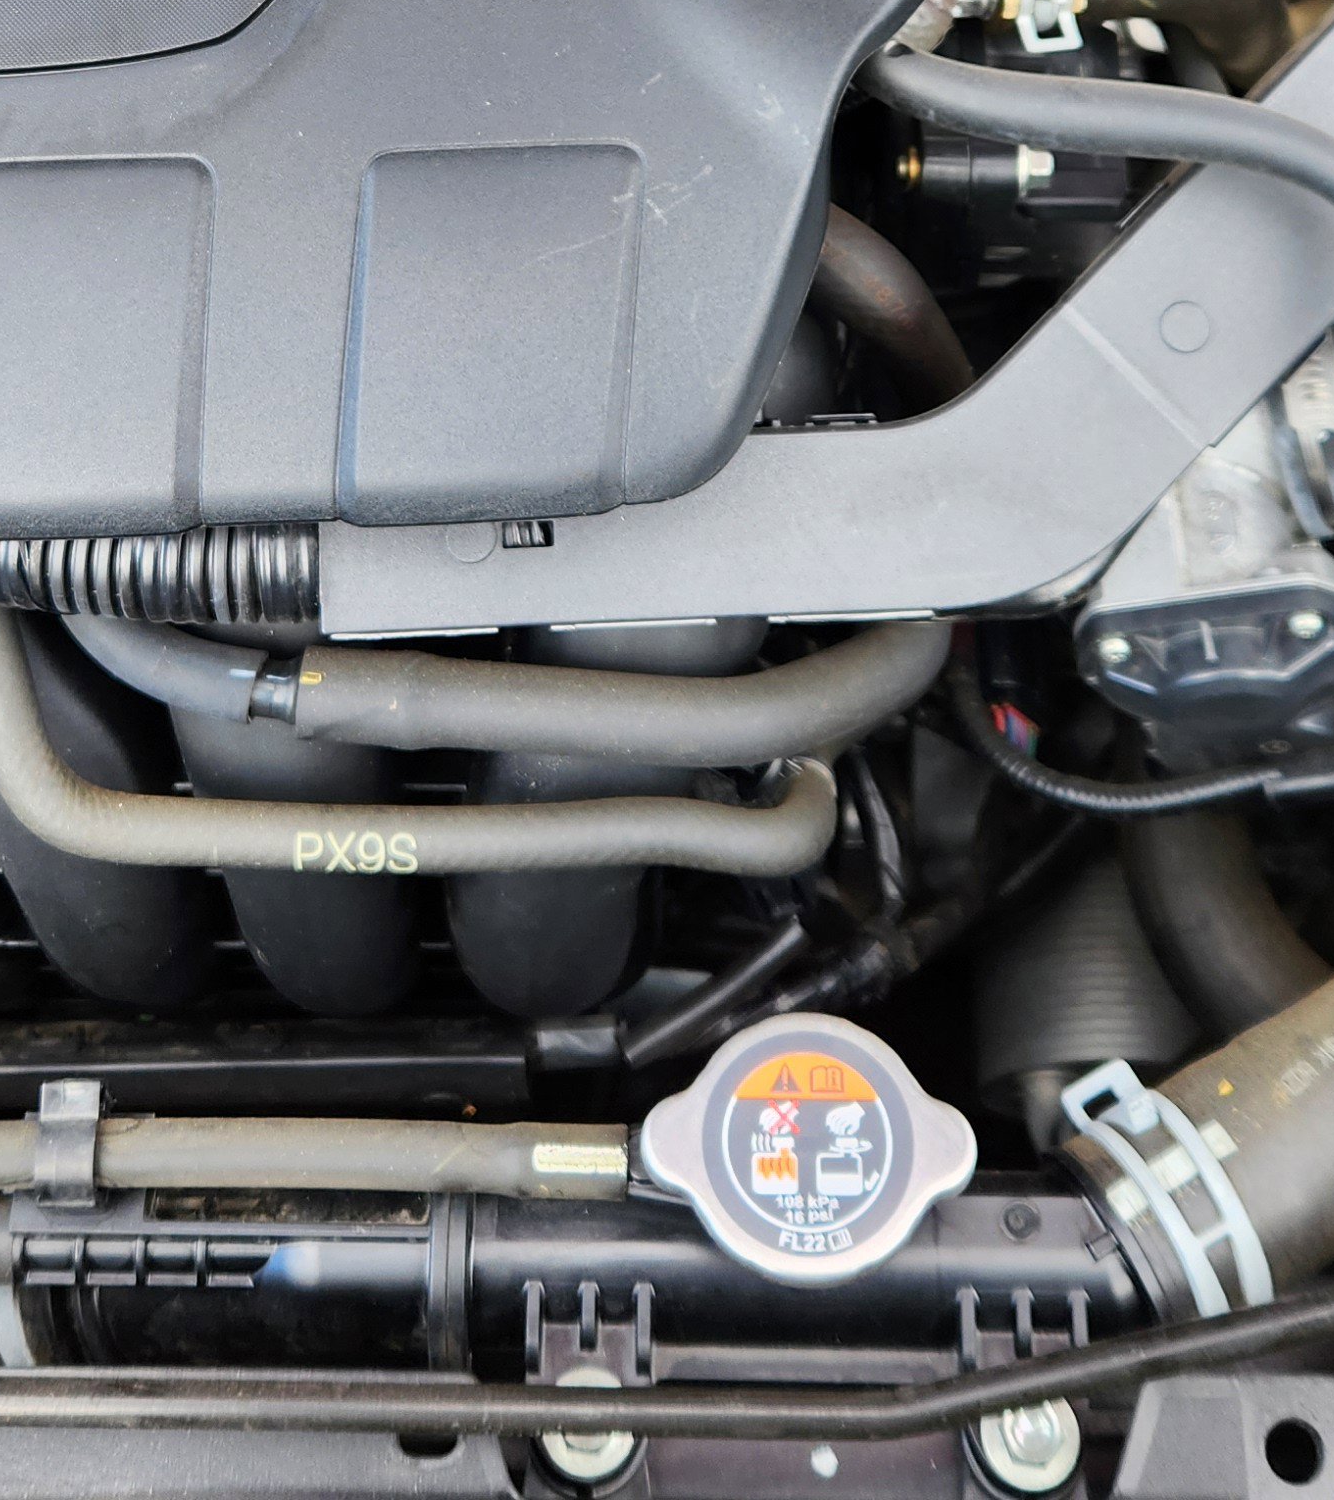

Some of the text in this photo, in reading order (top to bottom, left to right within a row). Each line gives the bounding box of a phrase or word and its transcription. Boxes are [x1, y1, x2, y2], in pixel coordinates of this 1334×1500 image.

[293, 831, 419, 875] PX9S
[774, 1192, 840, 1210] 108 kPa
[785, 1206, 834, 1225] 16 psi
[778, 1229, 826, 1253] FL22
